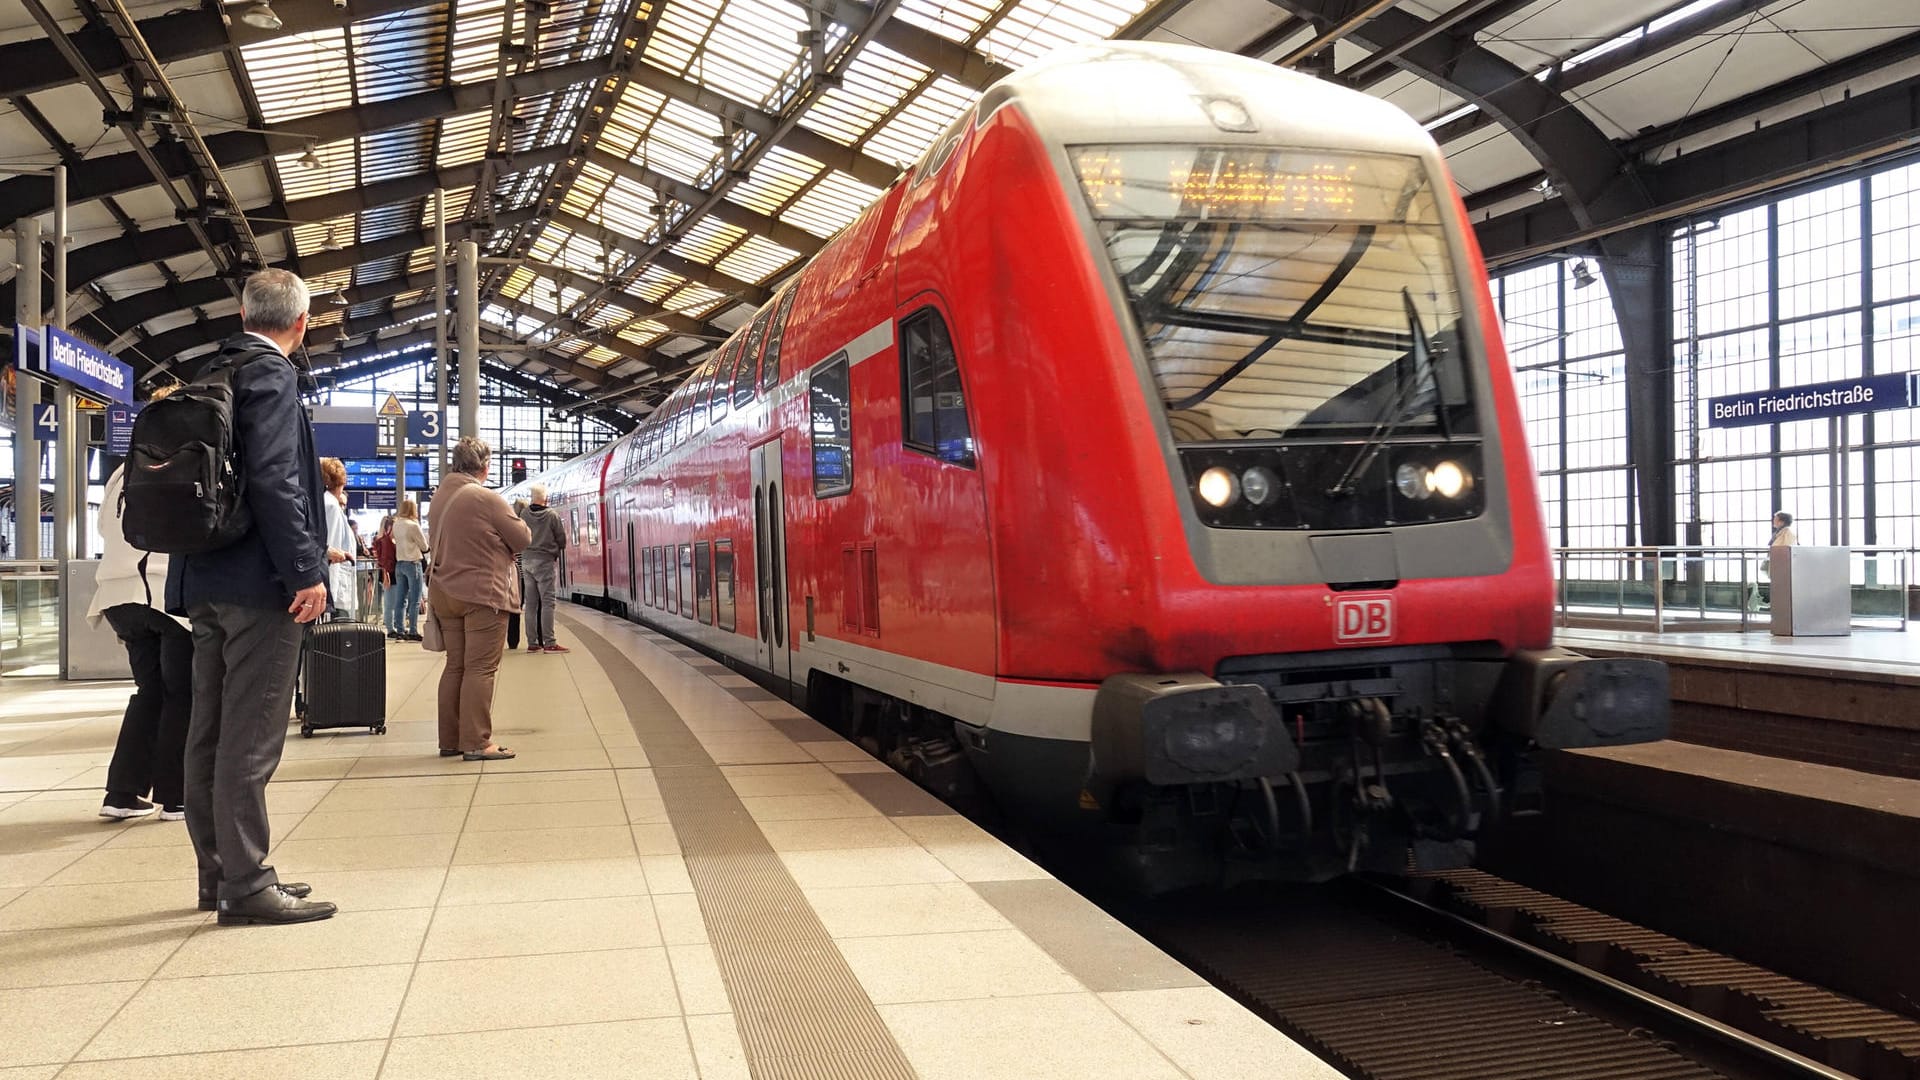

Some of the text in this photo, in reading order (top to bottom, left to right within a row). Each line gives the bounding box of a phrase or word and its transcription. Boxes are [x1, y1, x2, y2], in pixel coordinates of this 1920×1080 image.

[53, 336, 124, 389] Berlin Friedrichstraße
[1715, 385, 1874, 419] Berlin Friedrichstraße
[39, 405, 58, 432] 4
[421, 411, 439, 438] 3
[1344, 603, 1386, 635] DB
